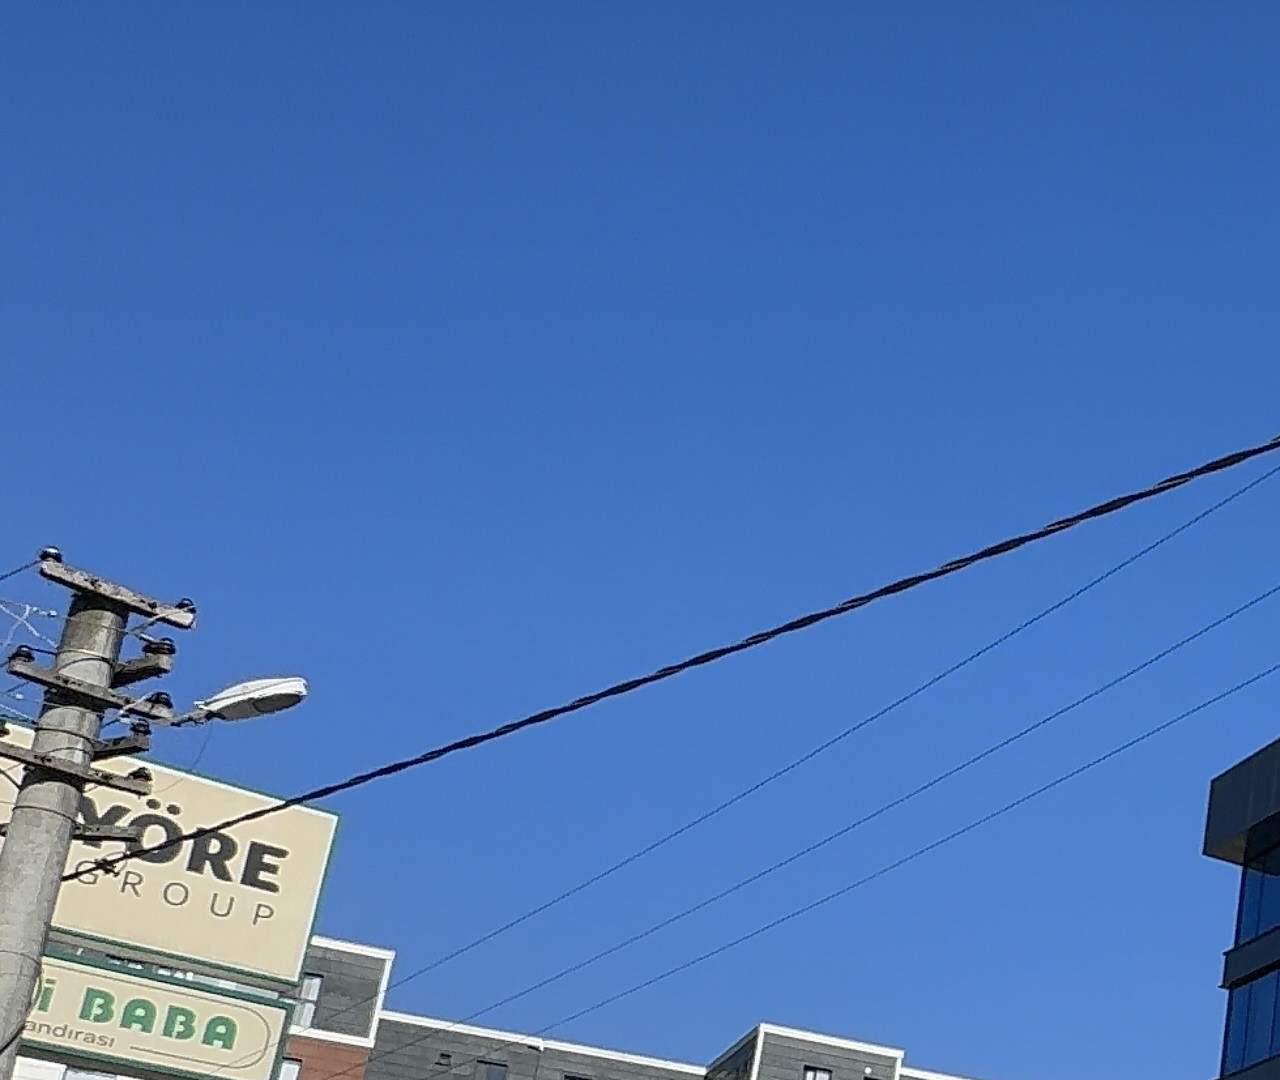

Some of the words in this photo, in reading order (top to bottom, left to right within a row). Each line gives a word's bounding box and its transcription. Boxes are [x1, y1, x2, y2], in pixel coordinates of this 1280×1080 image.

[76, 797, 289, 894] YÖRE
[75, 859, 275, 926] GROUP
[25, 1020, 116, 1048] andırası
[79, 986, 239, 1050] BABA
